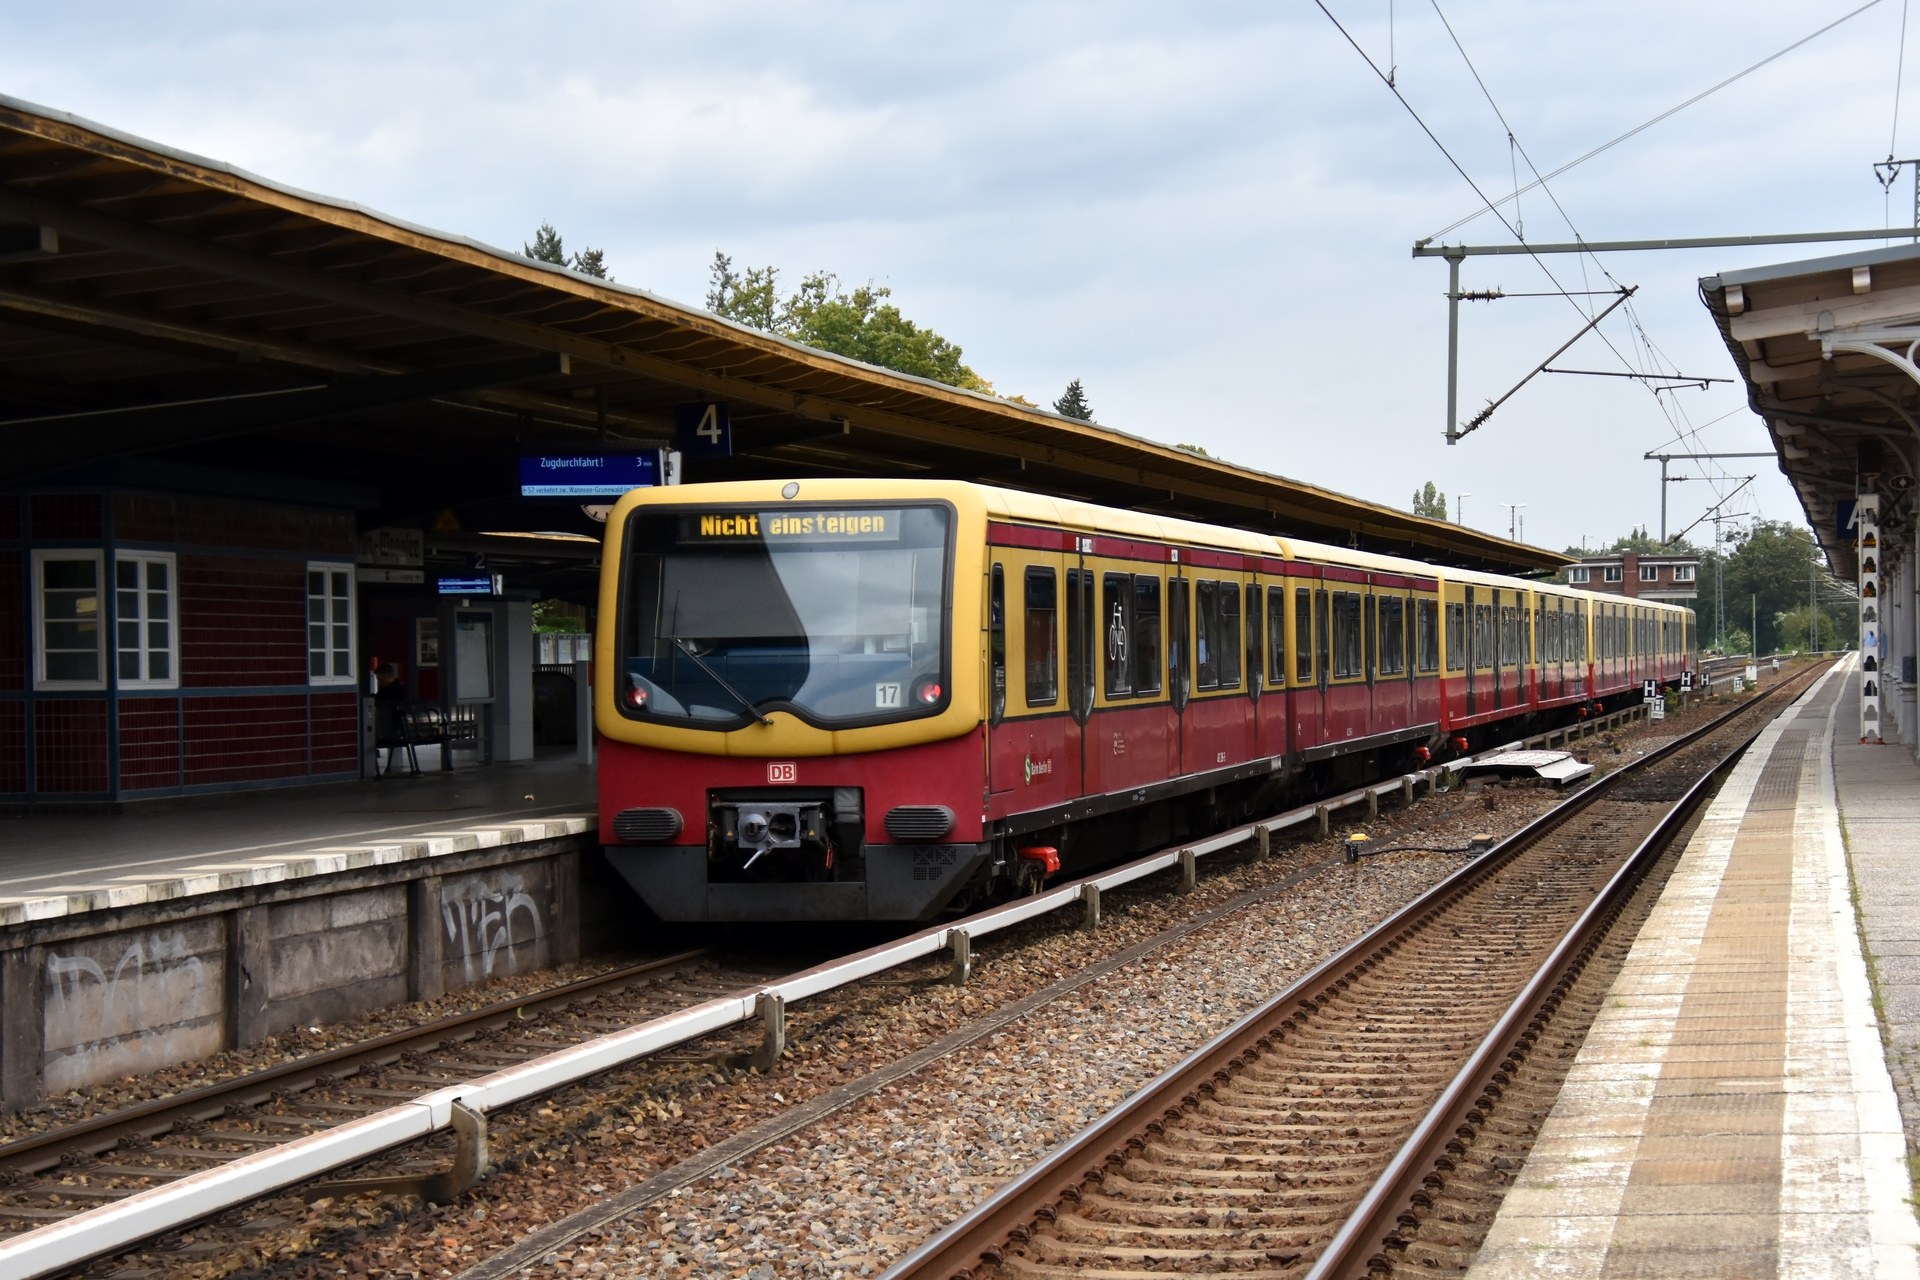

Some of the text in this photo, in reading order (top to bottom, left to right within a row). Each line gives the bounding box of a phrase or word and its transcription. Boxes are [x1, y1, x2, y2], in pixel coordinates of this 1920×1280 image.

[696, 404, 722, 444] 4
[636, 457, 642, 467] 3
[536, 486, 559, 494] verkehrt
[568, 486, 623, 494] Wannsee-Grunewald
[701, 514, 885, 536] Nicht einsteigen
[1347, 533, 1359, 550] 4
[475, 552, 486, 569] 2
[1681, 672, 1691, 686] H
[1701, 673, 1709, 686] H
[879, 685, 898, 704] 17
[1644, 680, 1656, 697] H
[771, 765, 793, 780] DB
[1025, 757, 1031, 782] S
